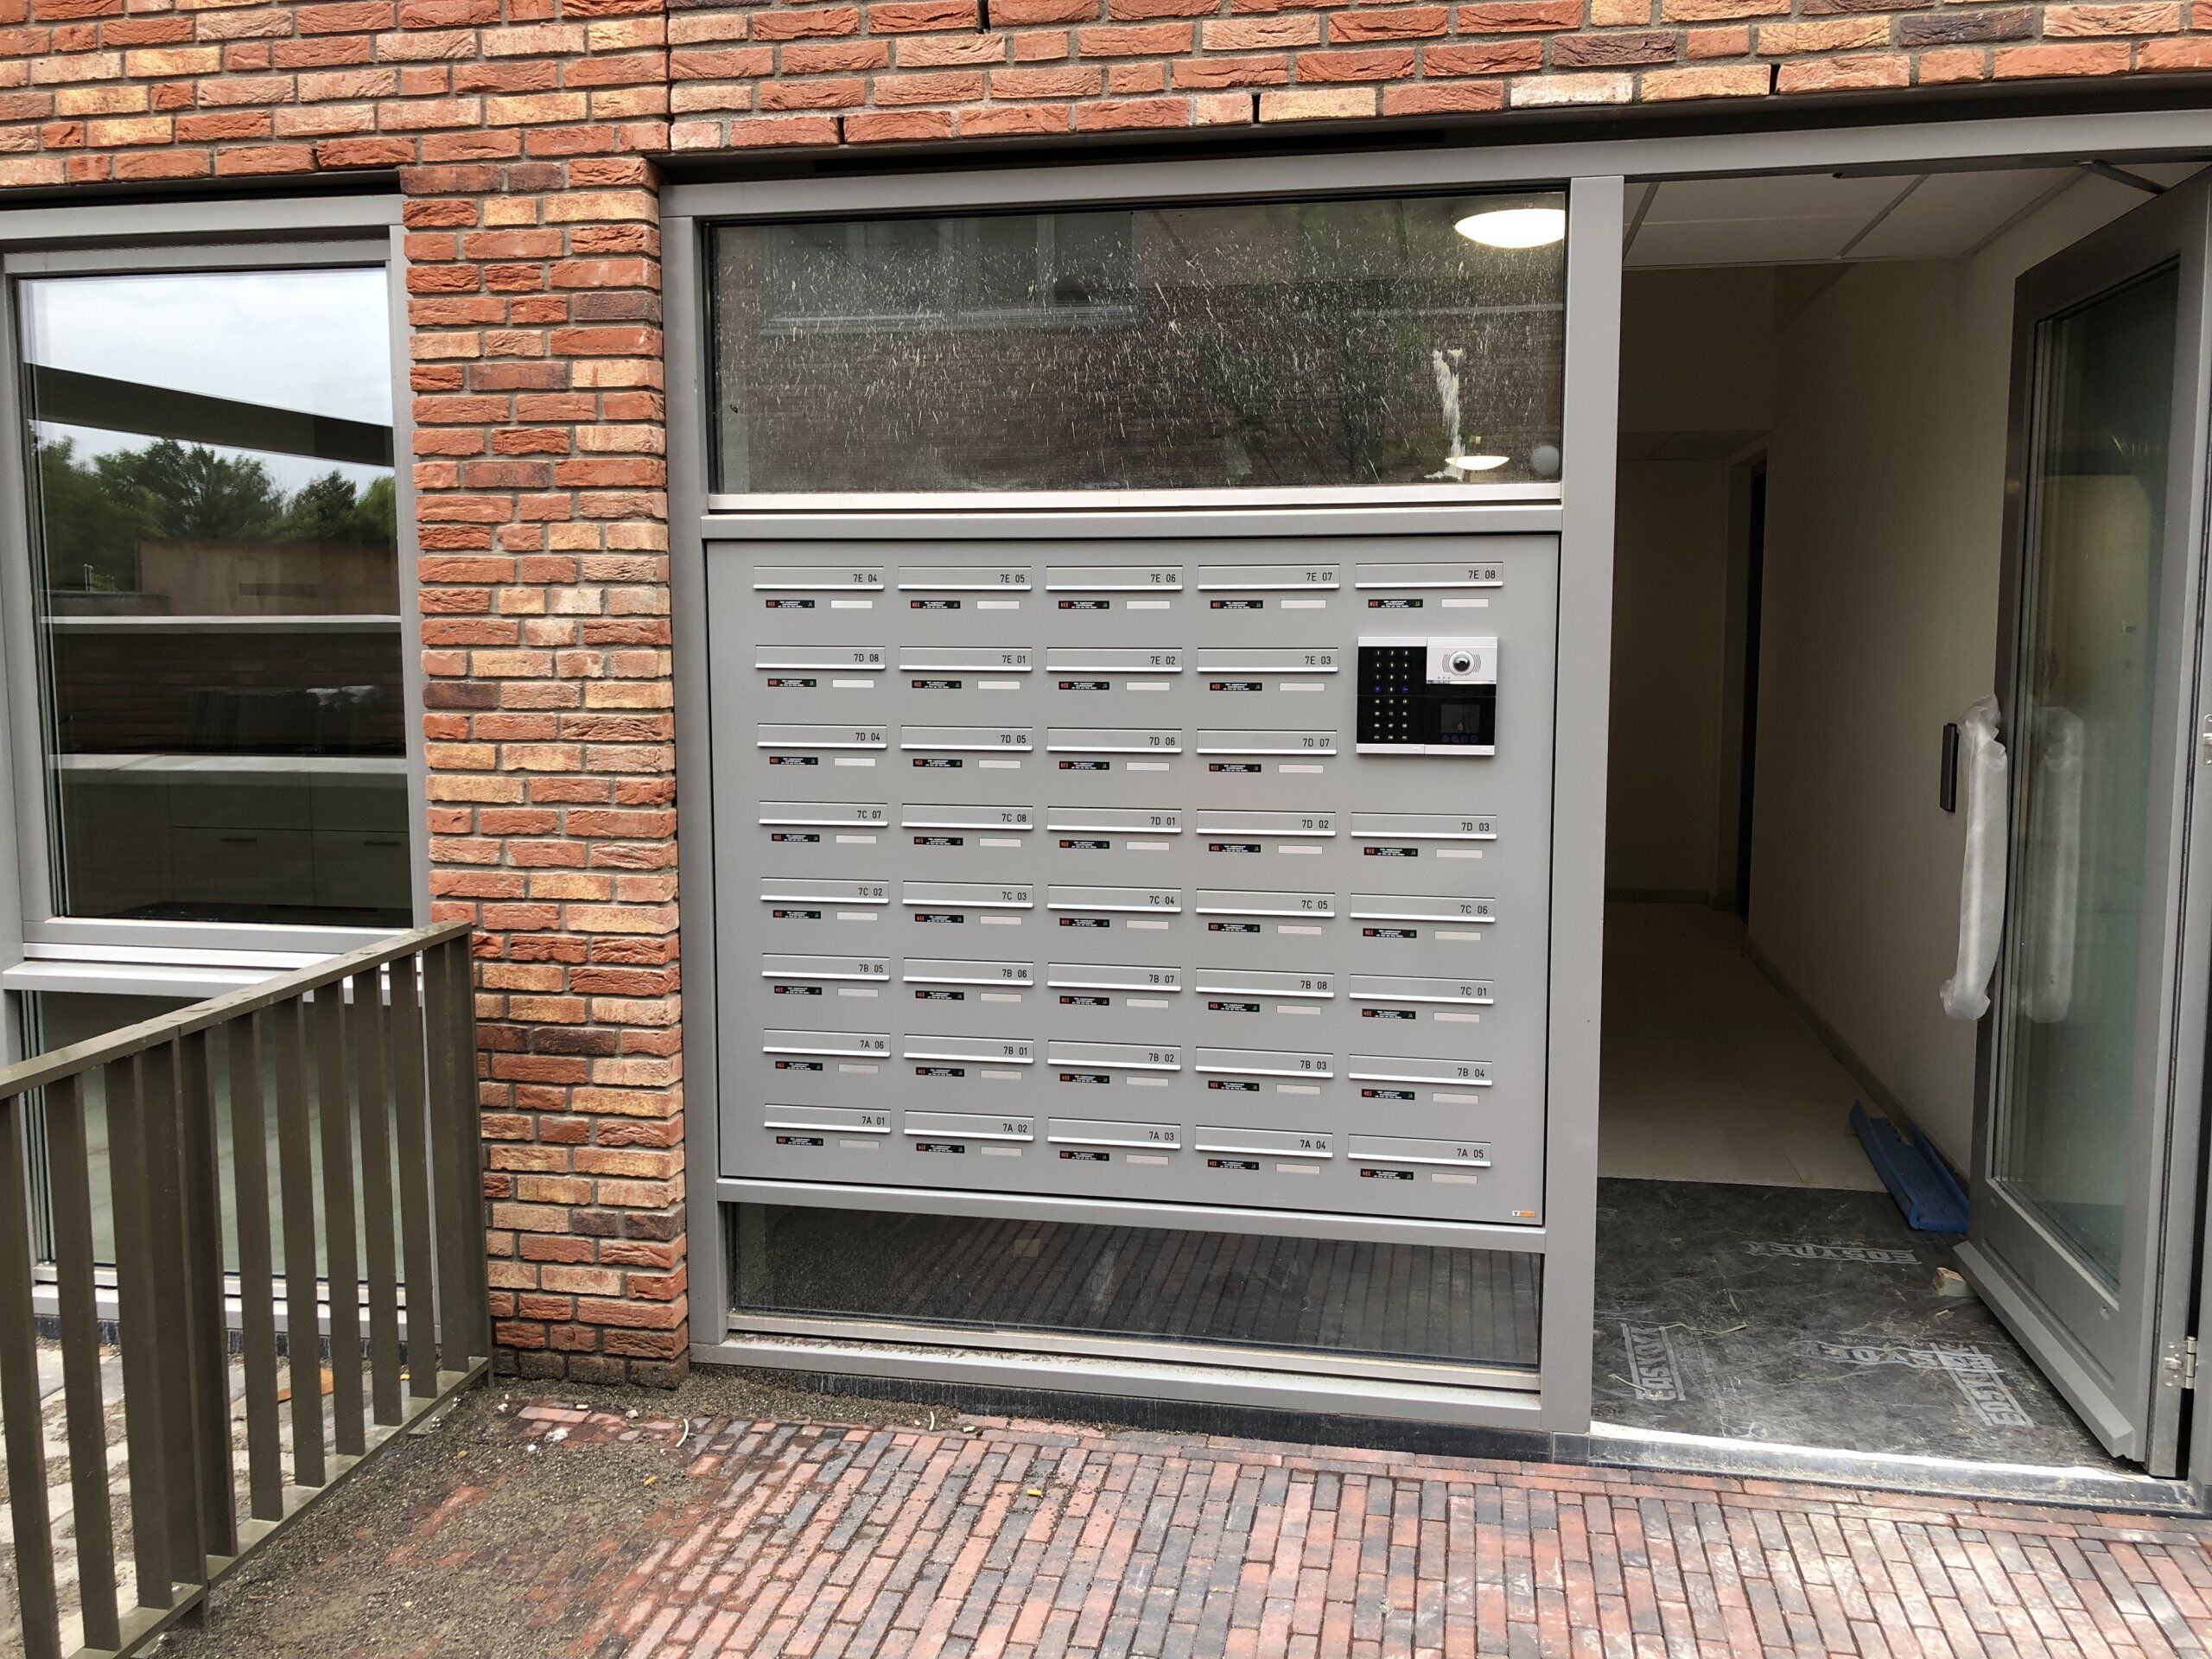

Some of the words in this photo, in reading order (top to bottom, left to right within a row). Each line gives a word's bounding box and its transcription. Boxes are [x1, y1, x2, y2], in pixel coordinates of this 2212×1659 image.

[853, 573, 863, 583] 7E
[868, 573, 878, 583] 04
[1000, 574, 1011, 583] 7E
[1014, 574, 1026, 583] 05
[1150, 573, 1161, 583] 7E
[1166, 573, 1176, 583] 06
[1306, 572, 1318, 582] 7E
[1322, 571, 1333, 582] 07
[1468, 569, 1480, 580] 7E
[1484, 569, 1496, 580] 08
[854, 653, 865, 663] 7D
[869, 653, 880, 663] 08
[1001, 654, 1013, 664] 7E
[1016, 654, 1026, 664] 01
[1150, 655, 1161, 665] 7E
[1165, 656, 1176, 665] 02
[1304, 655, 1316, 665] 7E
[1320, 655, 1332, 665] 03
[855, 732, 866, 741] 7D
[870, 732, 880, 741] 04
[1000, 734, 1012, 744] 7D
[1016, 734, 1027, 744] 05
[1148, 736, 1160, 746] 7D
[1165, 736, 1176, 747] 06
[1302, 737, 1314, 747] 7D
[1319, 738, 1330, 747] 07
[856, 810, 868, 819] 7C
[872, 810, 882, 819] 07
[1001, 812, 1013, 823] 7C
[1016, 813, 1027, 823] 08
[1150, 816, 1161, 826] 7D
[1166, 817, 1175, 826] 01
[1301, 819, 1313, 829] 7D
[1319, 819, 1329, 830] 02
[1460, 822, 1473, 832] 7D
[1478, 822, 1490, 832] 03
[857, 887, 869, 896] 7C
[873, 887, 883, 897] 02
[1001, 891, 1013, 900] 7C
[1017, 892, 1027, 901] 03
[1148, 895, 1160, 905] 7C
[1164, 895, 1175, 906] 04
[1301, 899, 1313, 910] 7C
[1317, 899, 1328, 910] 05
[1459, 904, 1472, 914] 7C
[1477, 905, 1488, 915] 06
[858, 963, 869, 973] 7B
[874, 963, 884, 974] 05
[1001, 969, 1013, 978] 7B
[1017, 969, 1027, 979] 06
[1148, 974, 1160, 983] 7B
[1164, 975, 1175, 984] 07
[1300, 980, 1312, 989] 7B
[1317, 981, 1328, 990] 08
[1460, 986, 1471, 996] 7C
[1477, 987, 1487, 996] 01
[860, 1039, 870, 1049] 7A
[874, 1040, 884, 1050] 06
[1003, 1046, 1014, 1055] 7B
[1019, 1046, 1027, 1056] 01
[1148, 1052, 1160, 1062] 7B
[1164, 1053, 1174, 1063] 02
[1300, 1059, 1311, 1070] 7B
[1316, 1060, 1327, 1071] 03
[1457, 1067, 1469, 1077] 7B
[1474, 1068, 1485, 1078] 04
[861, 1116, 873, 1125] 7A
[876, 1116, 885, 1126] 01
[1002, 1122, 1014, 1133] 7A
[1017, 1123, 1027, 1134] 02
[1148, 1130, 1160, 1141] 7A
[1164, 1131, 1174, 1141] 03
[1300, 1139, 1312, 1149] 7A
[1316, 1140, 1326, 1150] 04
[1456, 1147, 1468, 1158] 7A
[1473, 1148, 1484, 1159] 05
